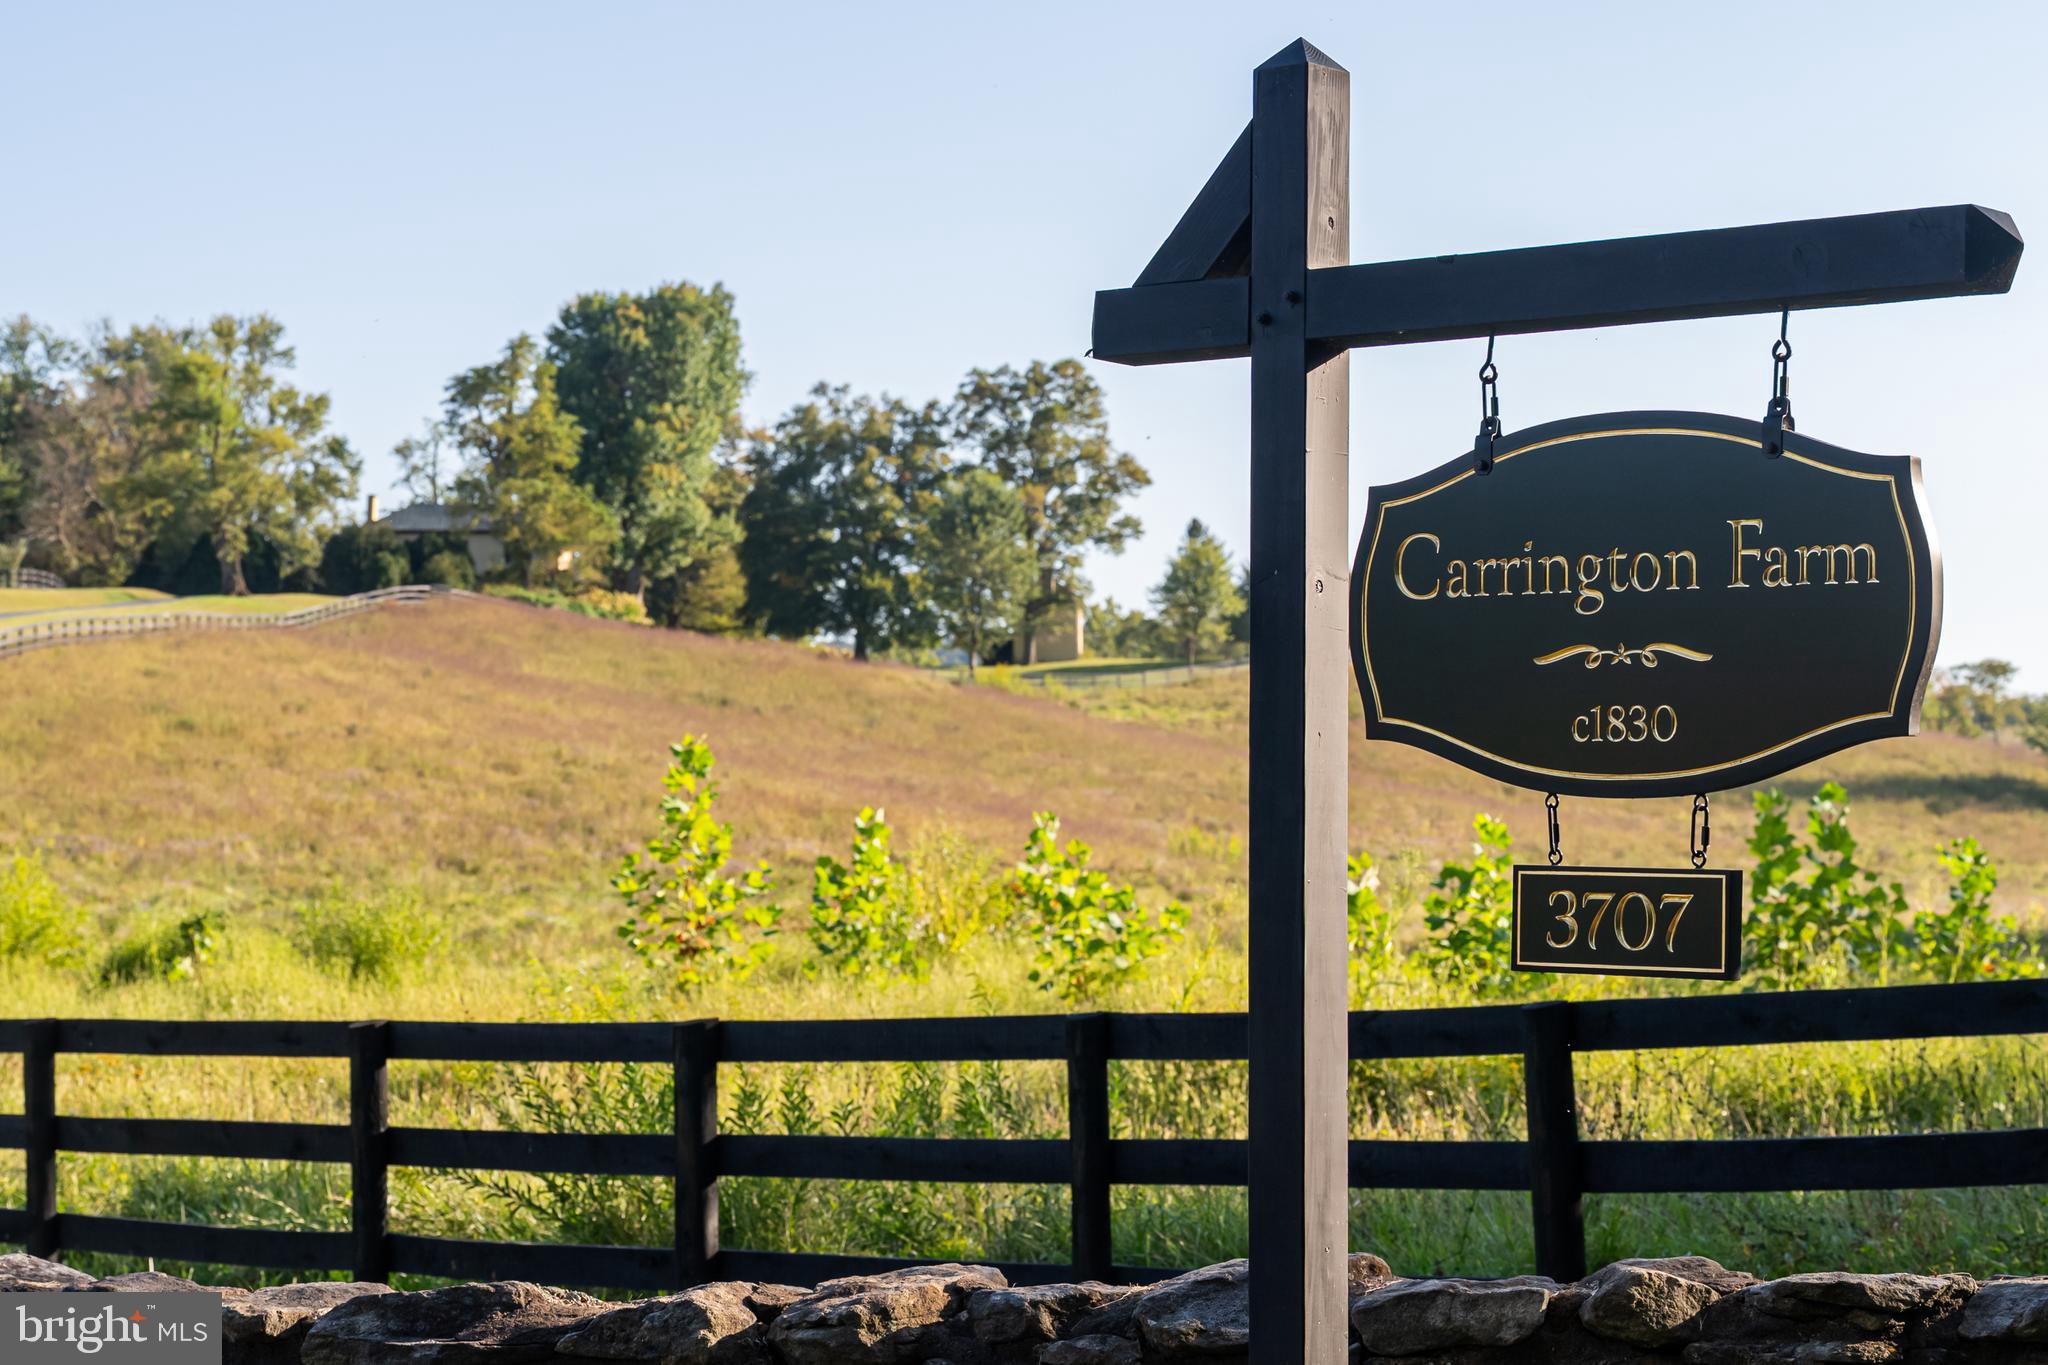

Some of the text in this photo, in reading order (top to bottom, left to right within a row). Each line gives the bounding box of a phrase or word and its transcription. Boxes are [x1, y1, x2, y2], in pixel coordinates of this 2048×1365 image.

[1394, 518, 1880, 615] Carrington Farm
[1571, 704, 1678, 743] c1830
[1546, 890, 1694, 953] 3707
